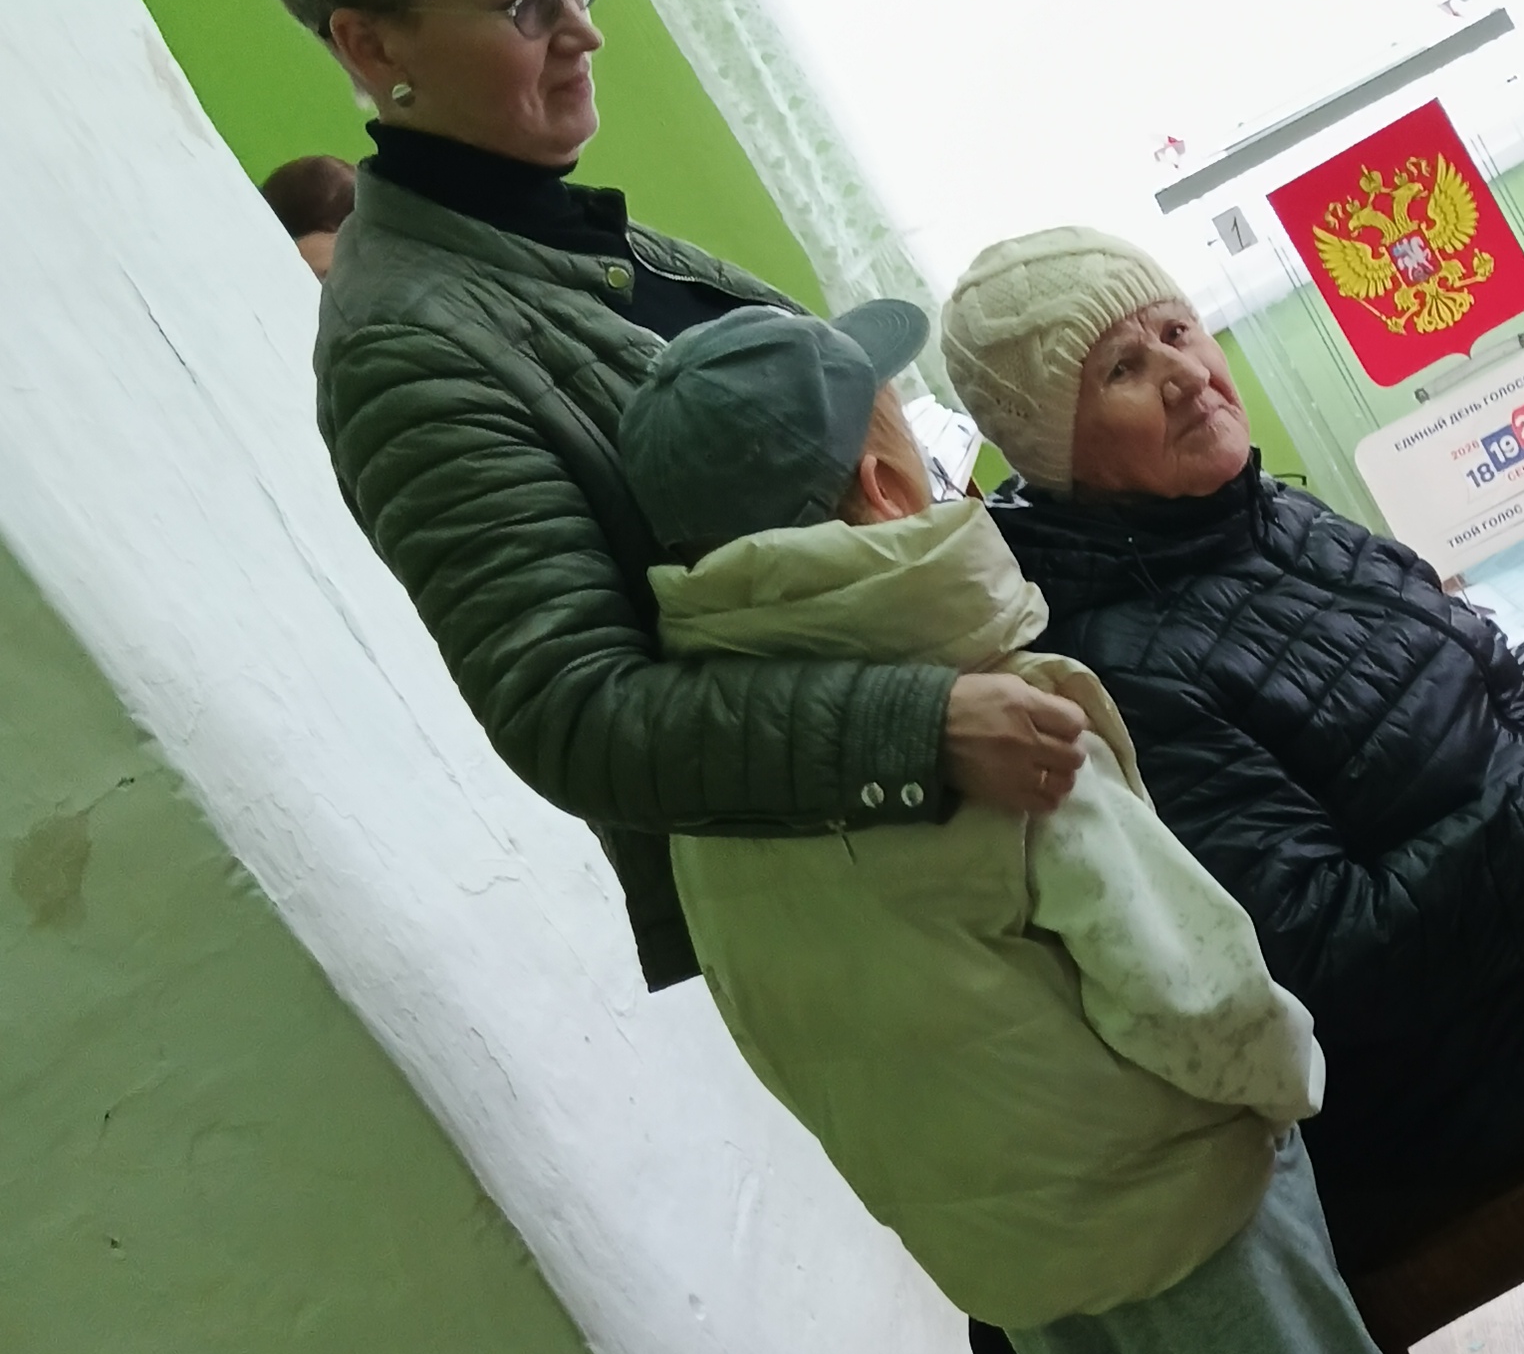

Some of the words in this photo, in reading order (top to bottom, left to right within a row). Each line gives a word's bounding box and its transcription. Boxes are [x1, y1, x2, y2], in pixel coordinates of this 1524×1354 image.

[1394, 416, 1447, 452] ЕДИНЫЙ
[1450, 402, 1482, 426] ДЕНЬ
[1489, 435, 1520, 464] 19
[1466, 463, 1495, 488] 18
[1447, 525, 1481, 549] ТВОЙ
[1482, 504, 1522, 530] ГОЛОС
